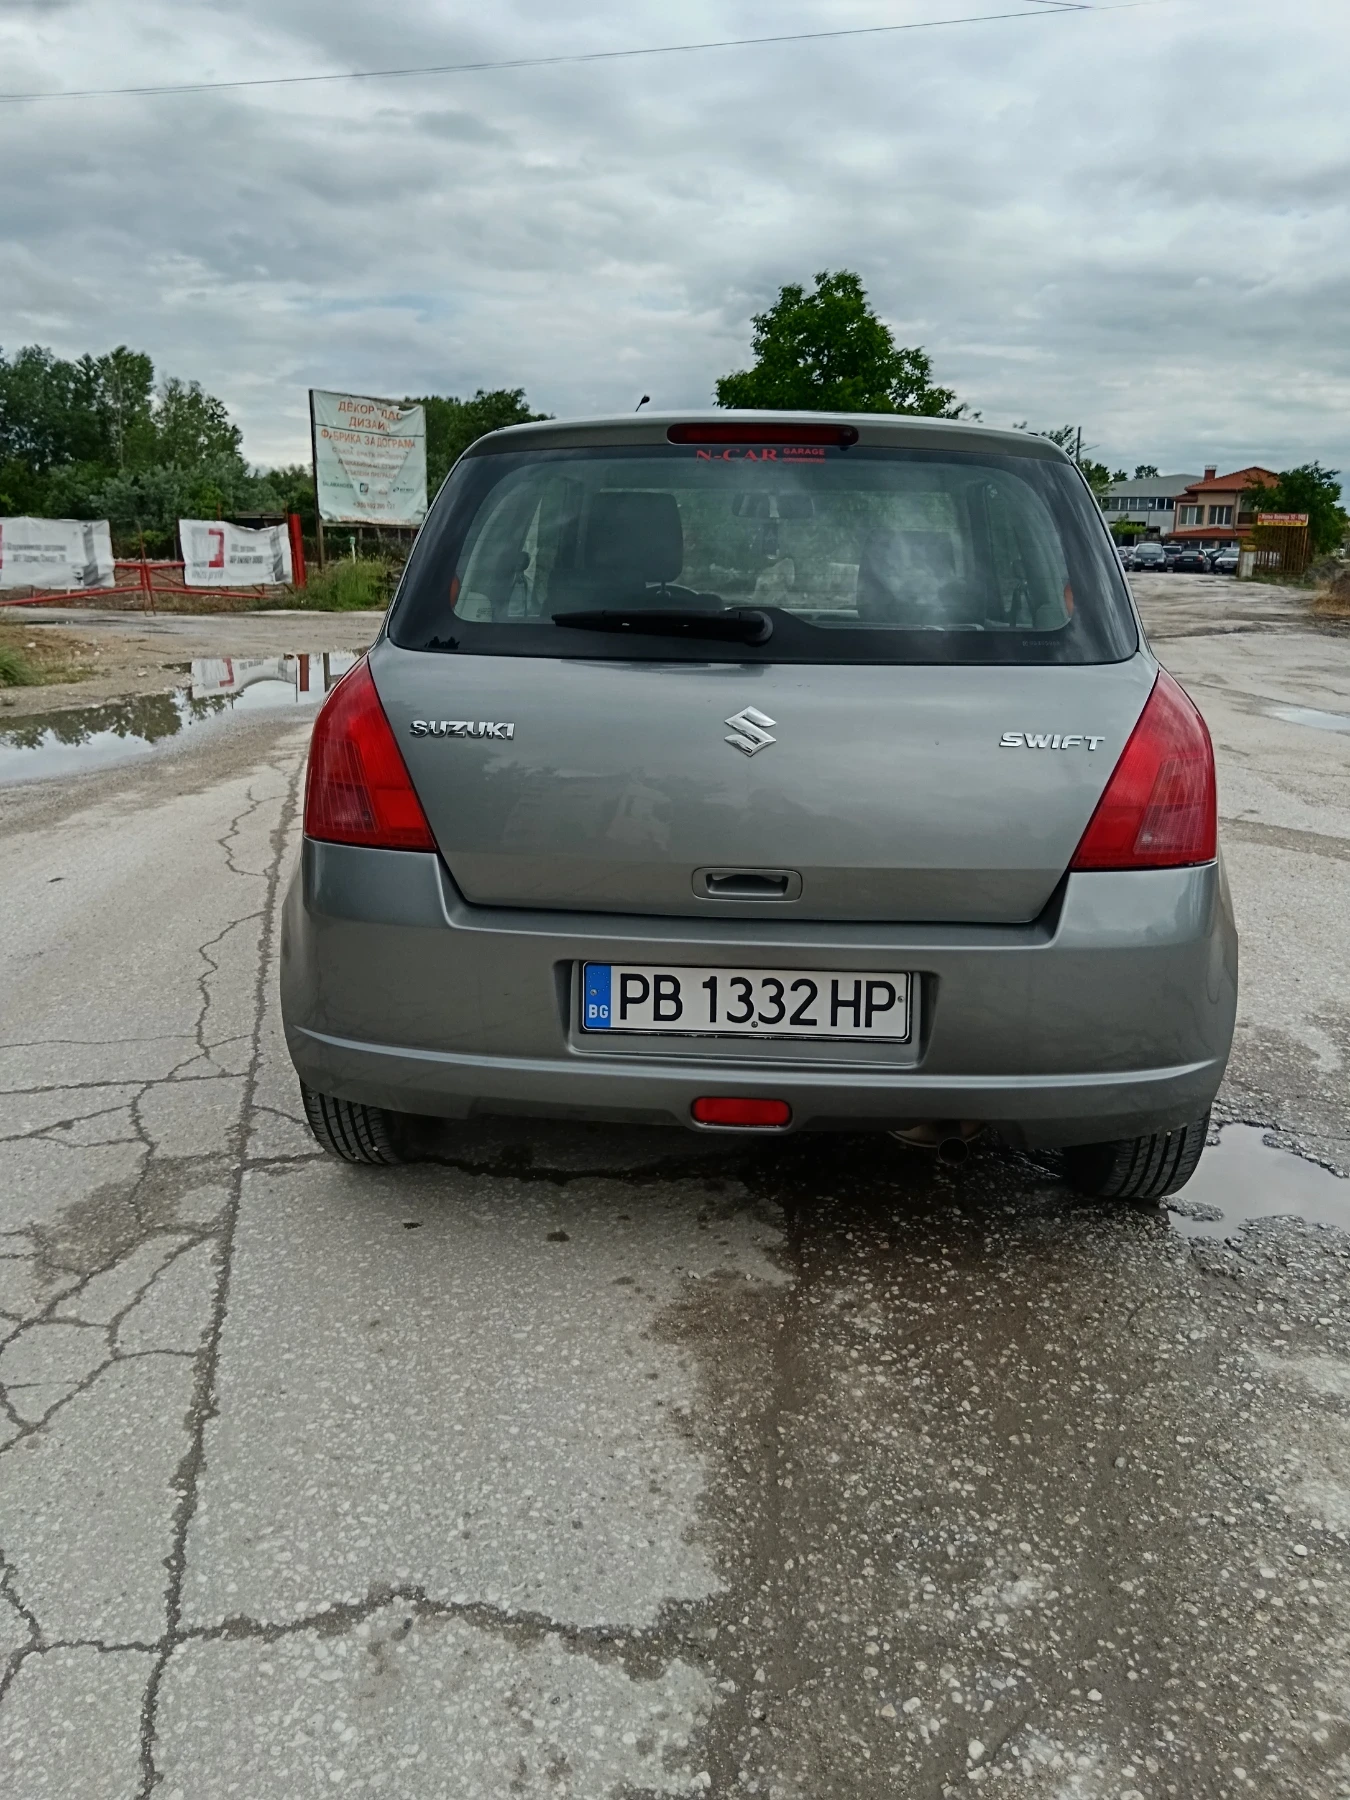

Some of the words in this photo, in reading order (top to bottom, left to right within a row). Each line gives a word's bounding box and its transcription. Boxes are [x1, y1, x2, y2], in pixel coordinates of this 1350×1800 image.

[338, 401, 375, 415] ДЕКОР
[321, 428, 361, 443] ФАБРИКА
[364, 436, 376, 446] ЗА
[696, 448, 778, 463] N-CAR
[783, 447, 825, 456] GARAGE
[409, 720, 516, 740] SUZUKI
[999, 731, 1106, 751] SWIFT
[619, 973, 683, 1022] PB
[702, 975, 818, 1027] 1332
[830, 979, 897, 1028] HP
[588, 1003, 609, 1019] BG
